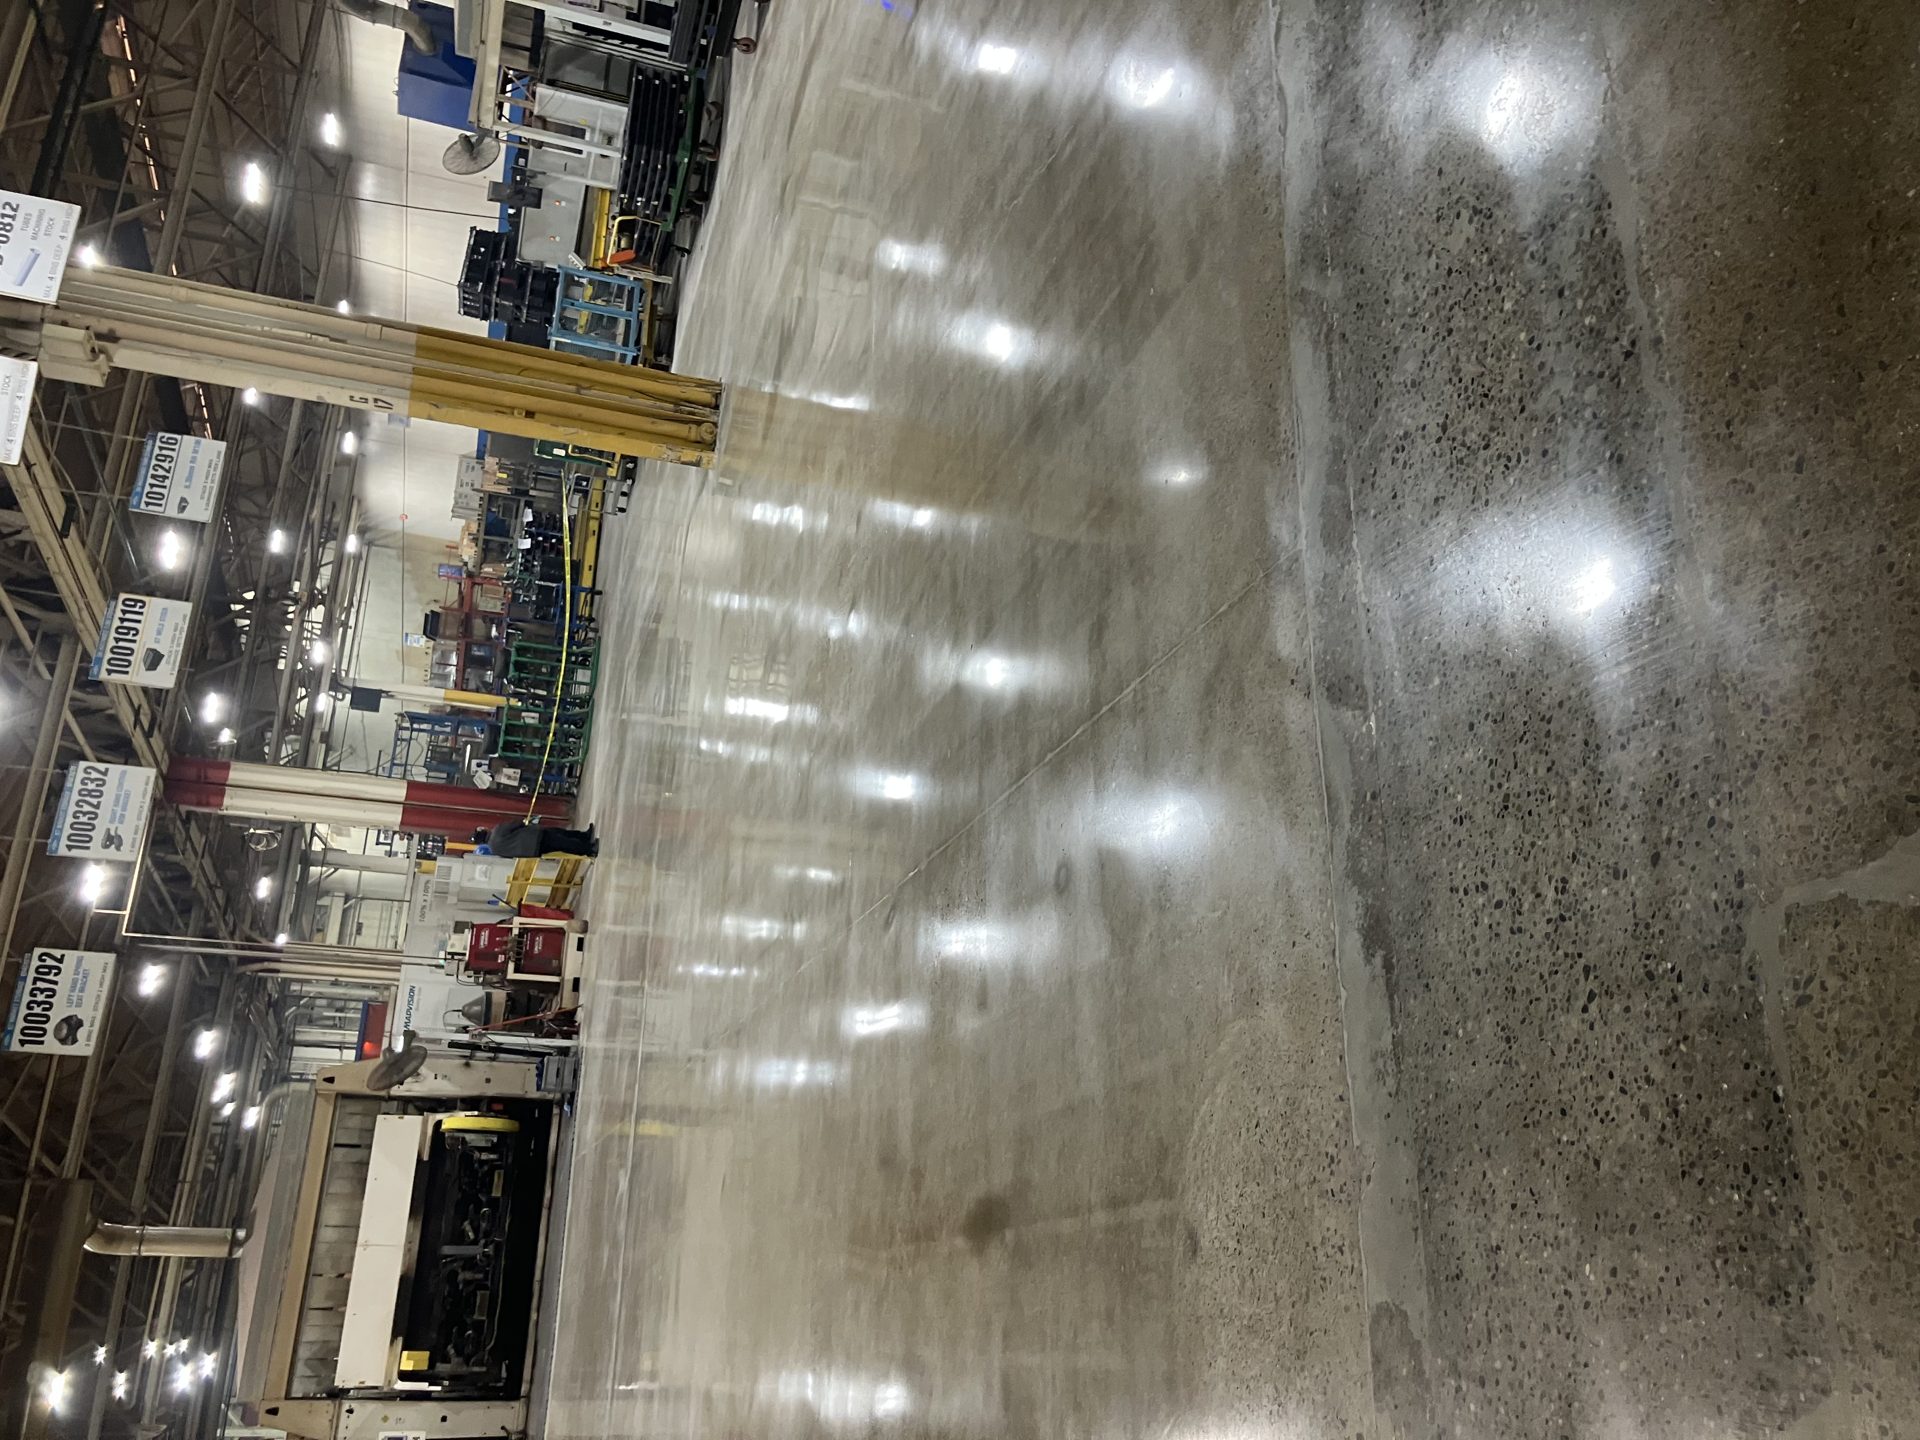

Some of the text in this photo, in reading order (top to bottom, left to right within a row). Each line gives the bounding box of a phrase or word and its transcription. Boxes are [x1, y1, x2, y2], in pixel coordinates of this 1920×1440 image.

[20, 213, 32, 231] TUBES
[43, 217, 55, 236] STOCK
[0, 375, 12, 395] STOCK
[349, 395, 368, 404] G
[373, 398, 393, 410] 17
[144, 435, 178, 508] 10142916
[105, 598, 146, 676] 10019119
[66, 766, 109, 852] 10032832
[18, 952, 65, 1047] 10033792
